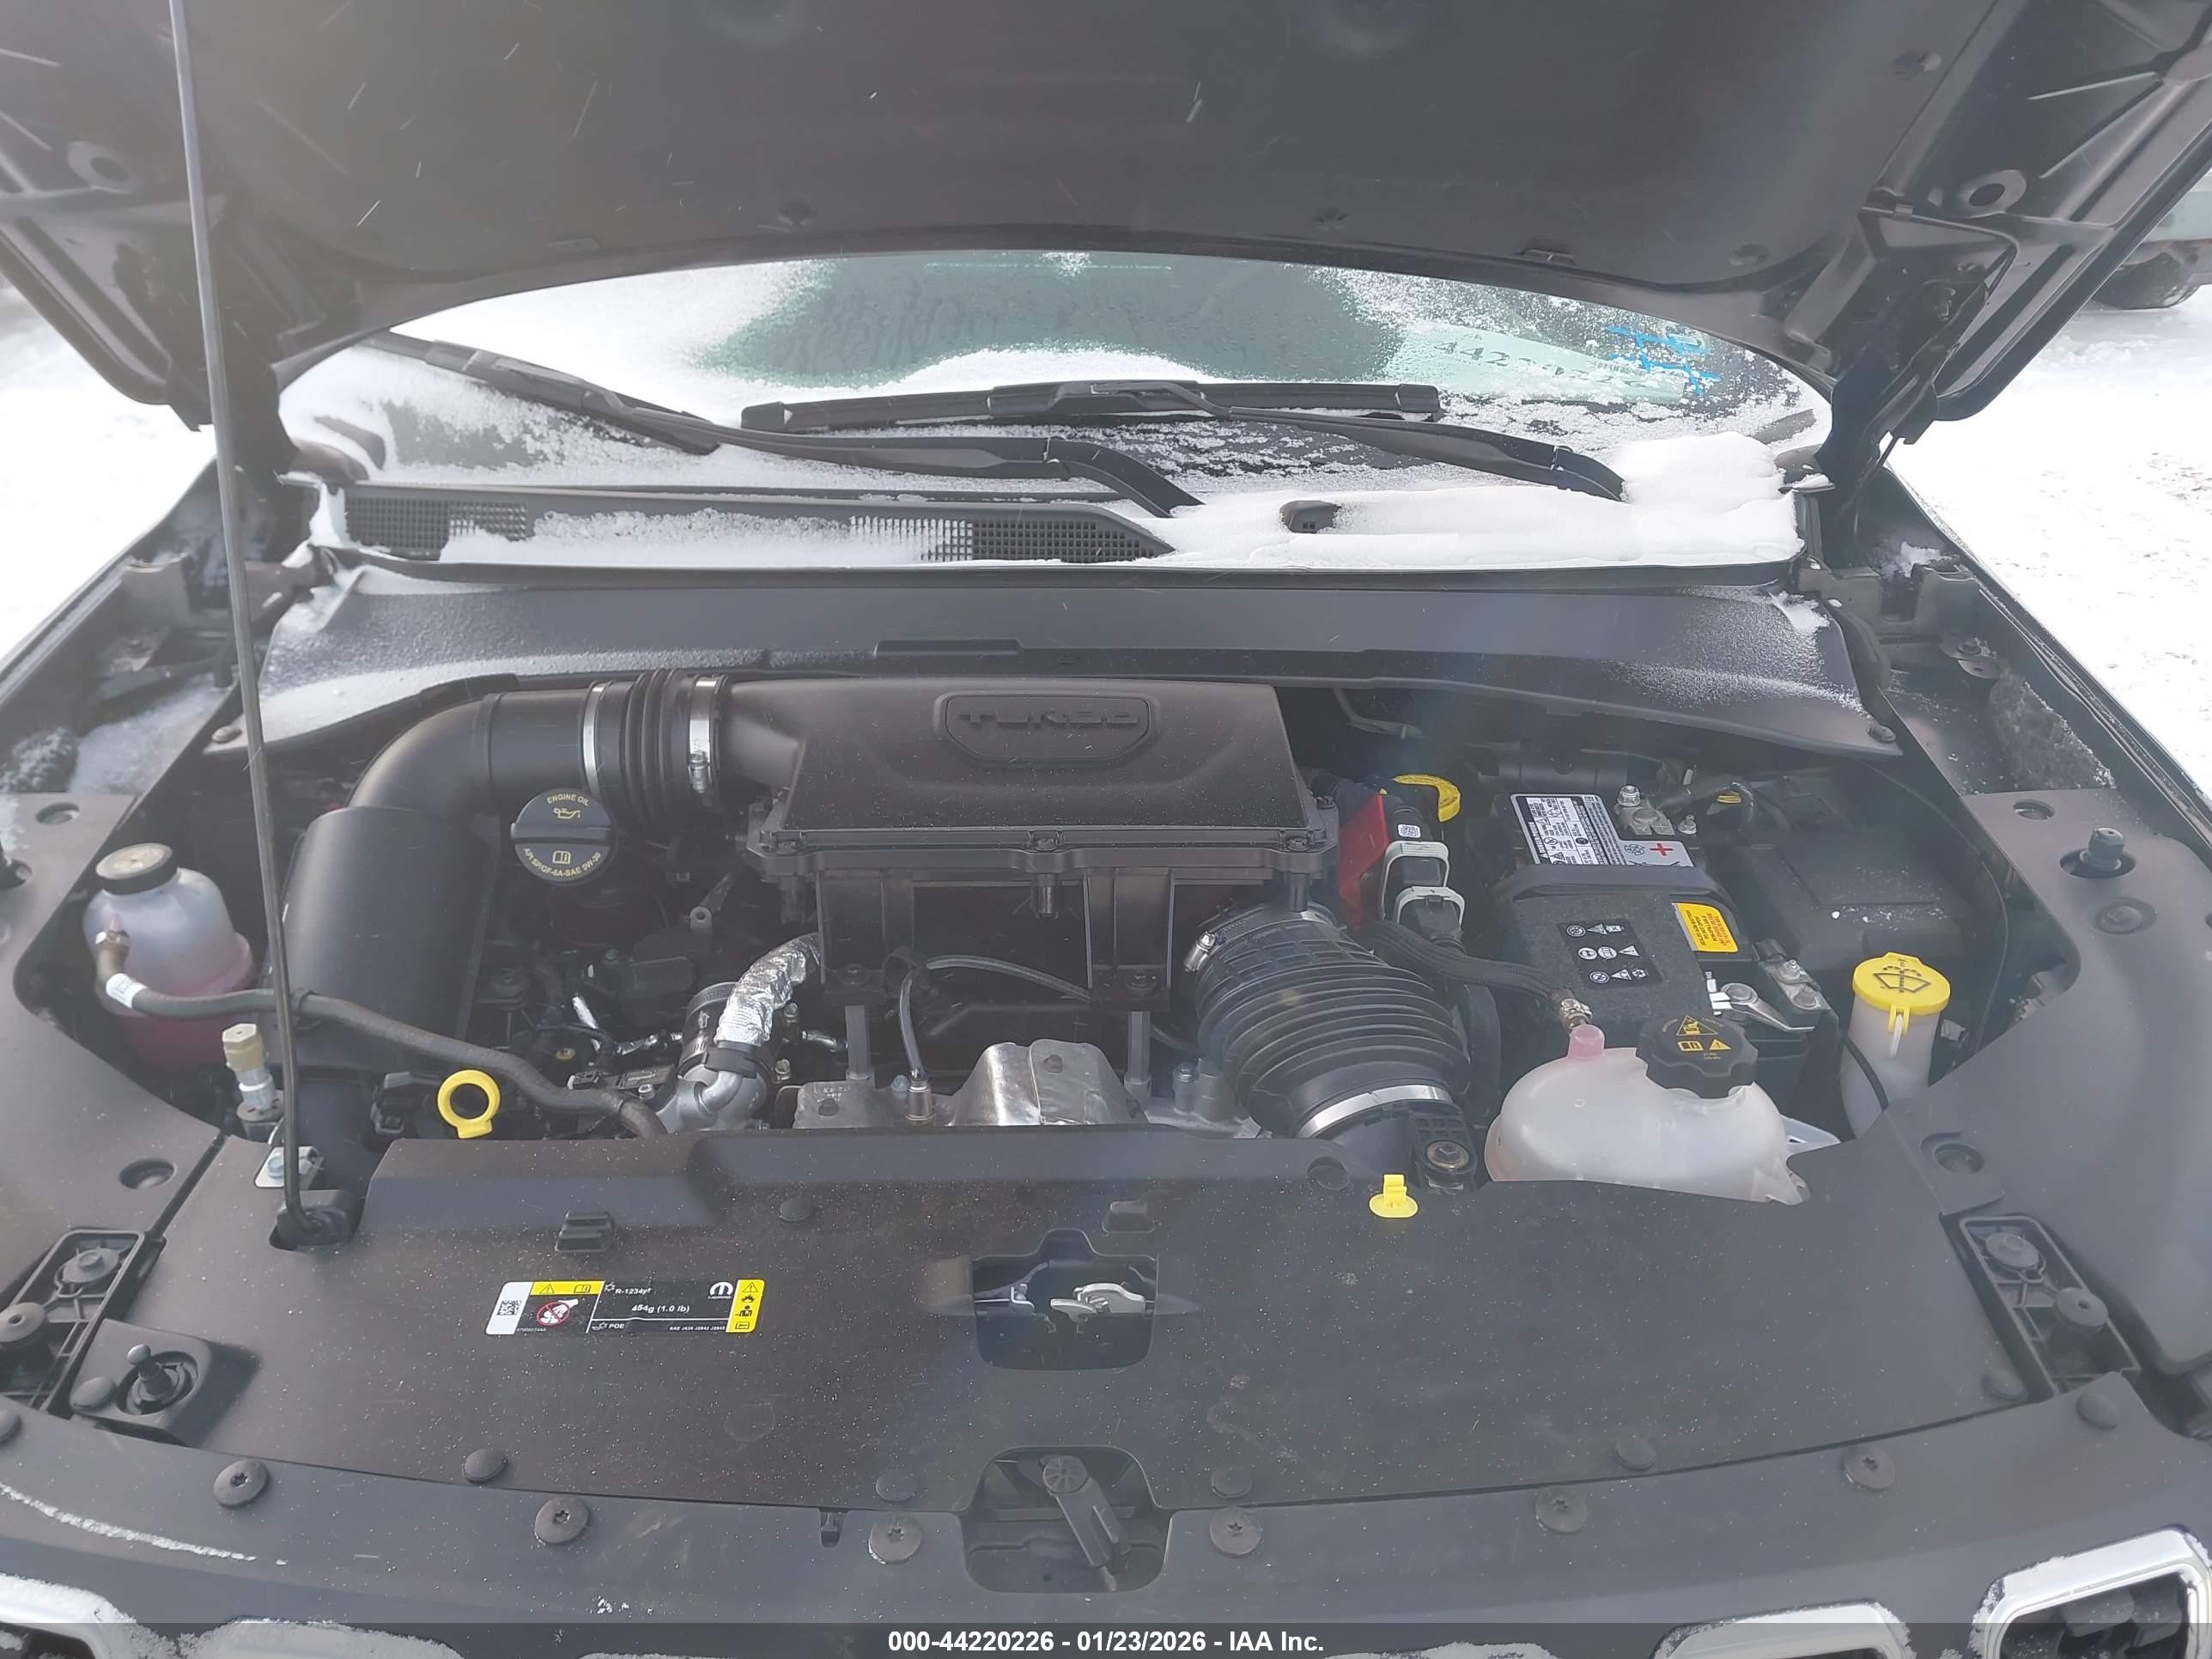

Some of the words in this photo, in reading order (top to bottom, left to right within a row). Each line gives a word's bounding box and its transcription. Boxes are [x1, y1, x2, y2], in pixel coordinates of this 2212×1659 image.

[958, 708, 1138, 728] TURBO
[547, 793, 577, 804] ENGINE
[577, 796, 589, 806] OIL
[523, 848, 534, 860] API
[615, 1287, 652, 1296] R-1234yf
[632, 1304, 654, 1314] 454g
[657, 1304, 675, 1314] (1.0
[678, 1304, 690, 1314] lb)
